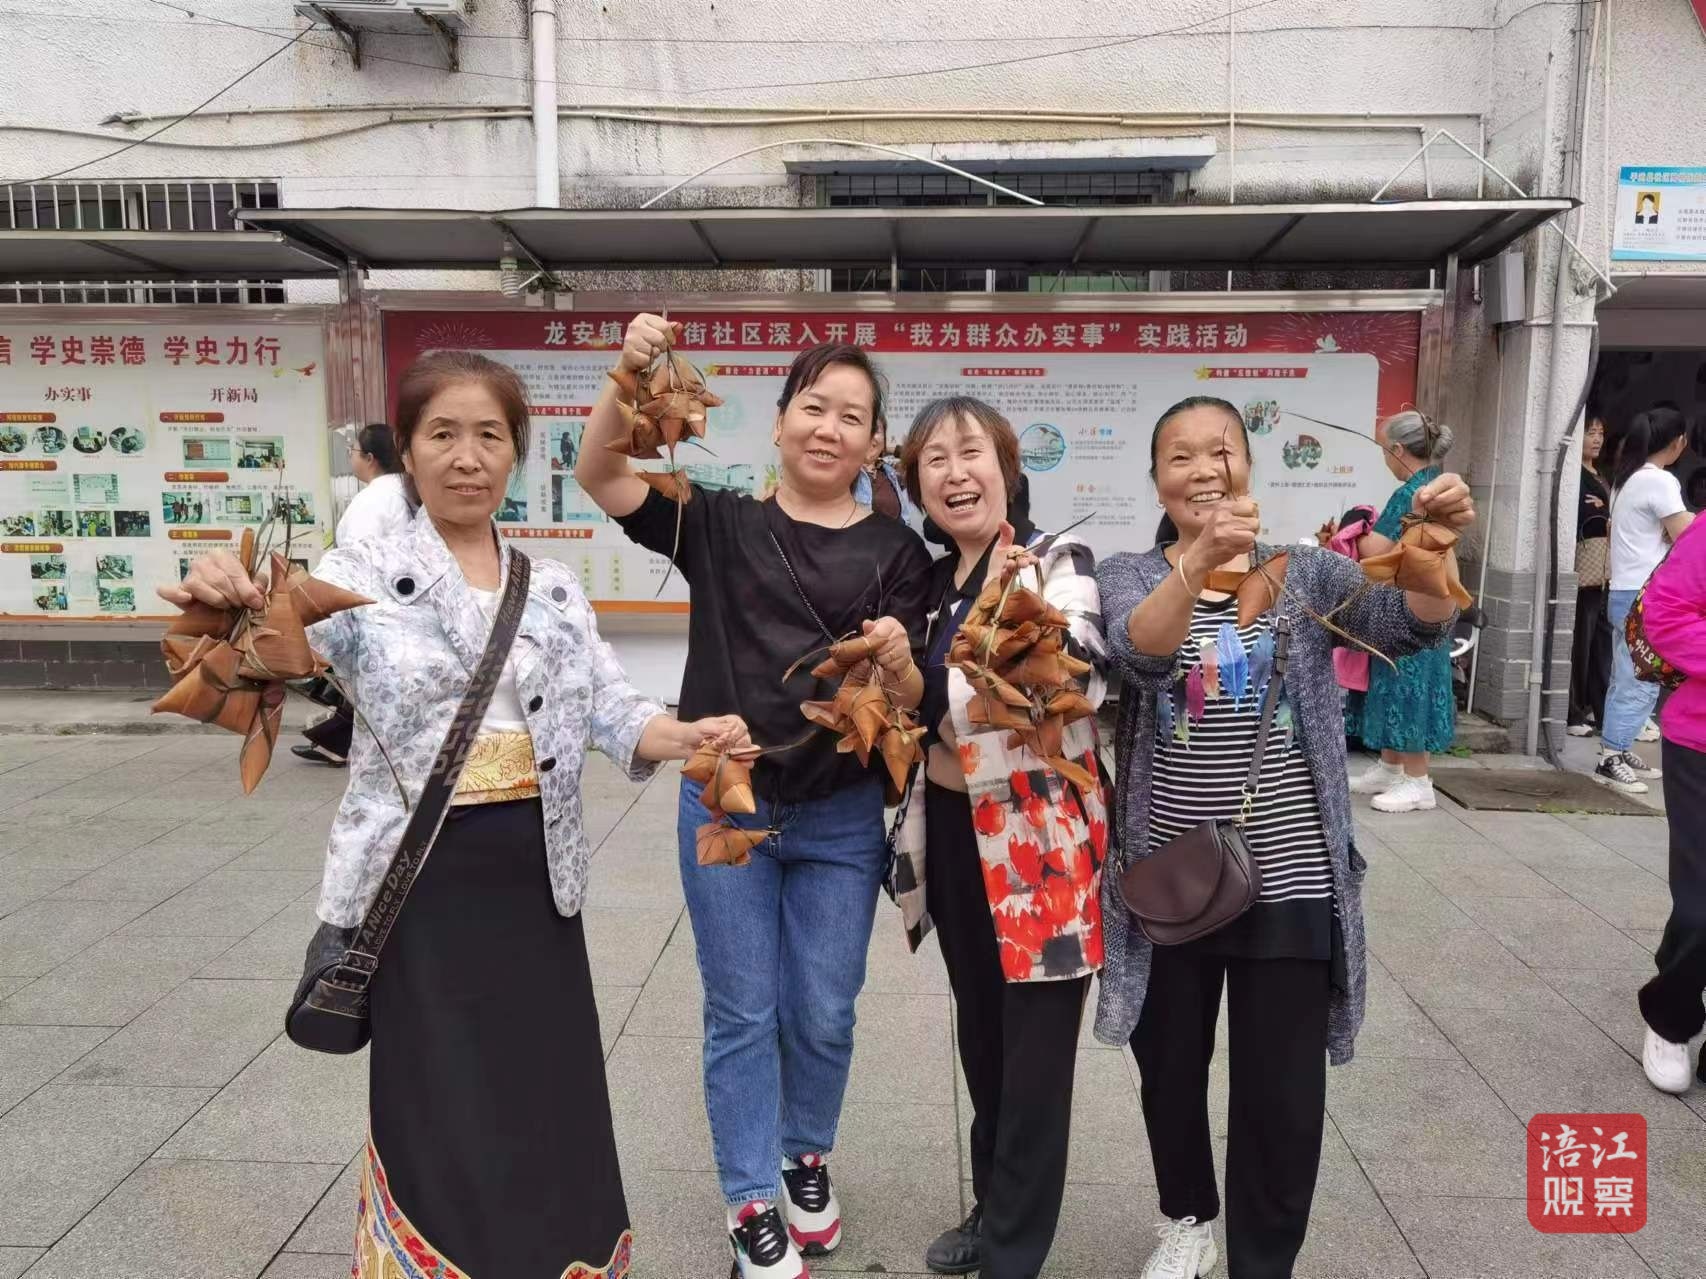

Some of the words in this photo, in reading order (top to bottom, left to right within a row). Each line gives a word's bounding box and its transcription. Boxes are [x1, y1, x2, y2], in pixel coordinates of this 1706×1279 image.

[30, 336, 146, 365] 学史崇德
[164, 336, 281, 366] 学史力行
[45, 387, 91, 401] 办实事
[211, 387, 258, 403] 开新局
[367, 890, 393, 931] Nice
[386, 850, 412, 889] Day
